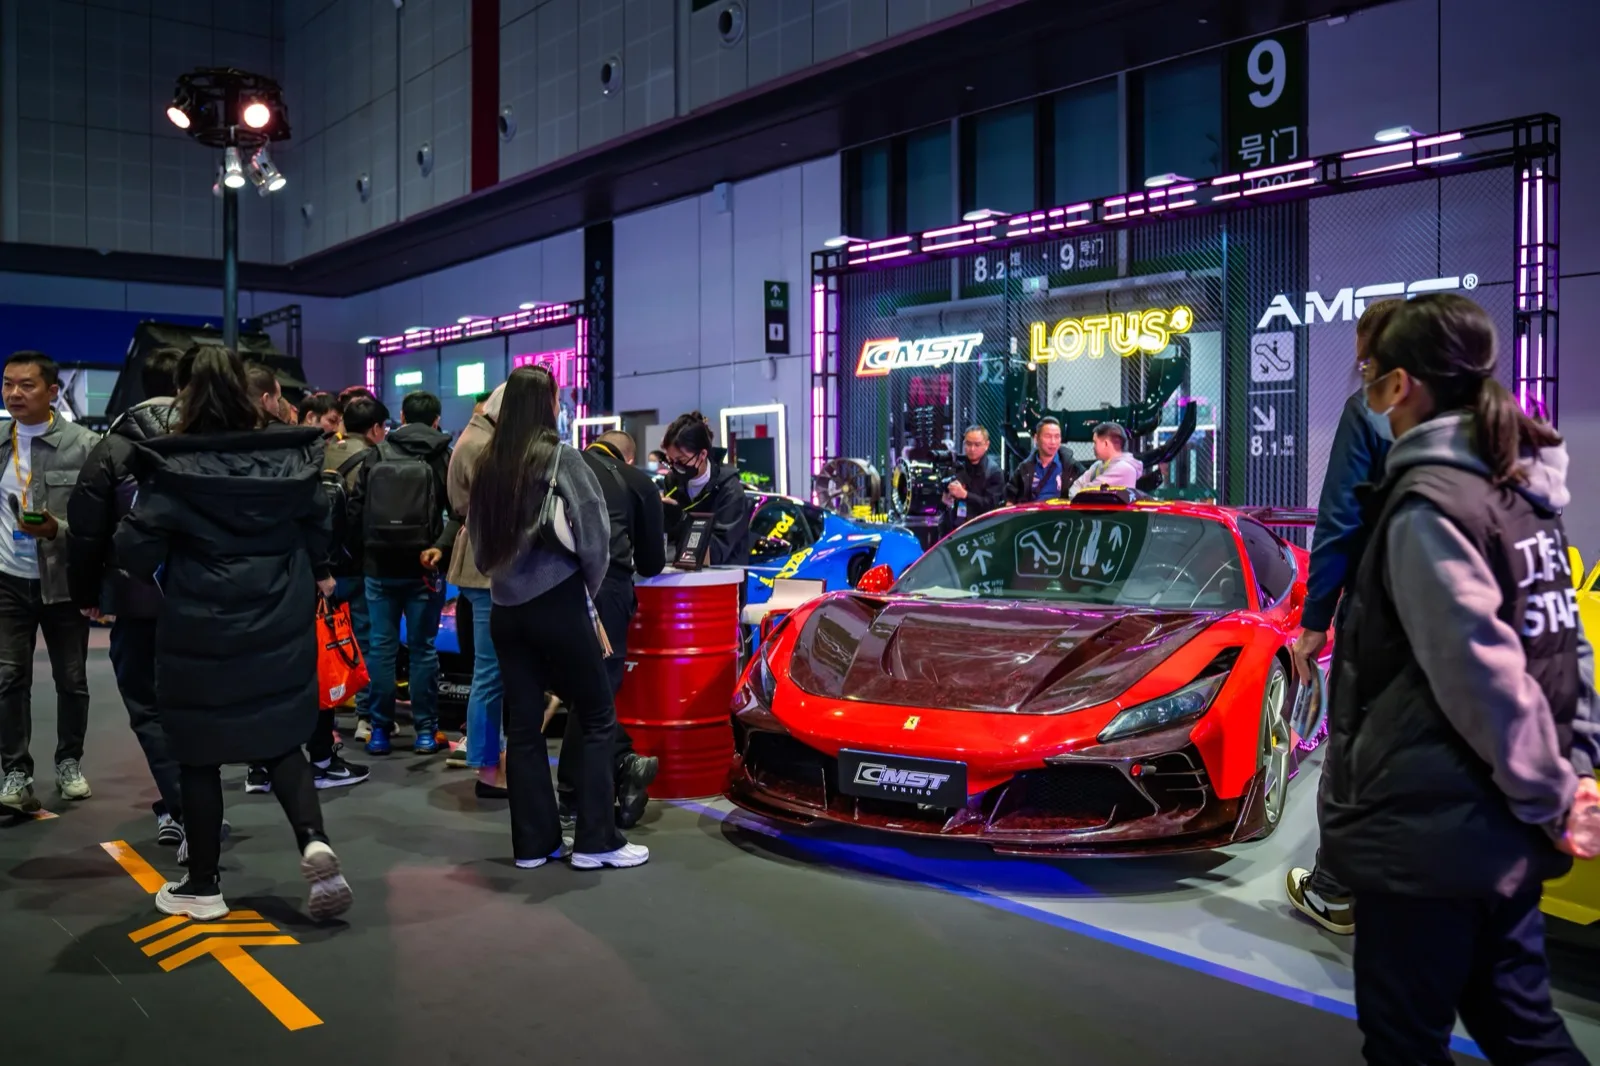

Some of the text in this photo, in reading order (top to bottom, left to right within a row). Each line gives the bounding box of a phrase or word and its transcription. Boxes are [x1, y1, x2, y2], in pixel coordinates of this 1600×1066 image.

[1246, 38, 1287, 109] 9
[1237, 125, 1298, 168] 号门
[1250, 171, 1296, 191] oor
[974, 255, 1005, 282] 8.2
[1059, 243, 1075, 271] 9
[1030, 307, 1171, 364] LOTUS
[1250, 434, 1277, 457] 8.1
[853, 761, 950, 790] CMST
[882, 784, 932, 797] TUNING
